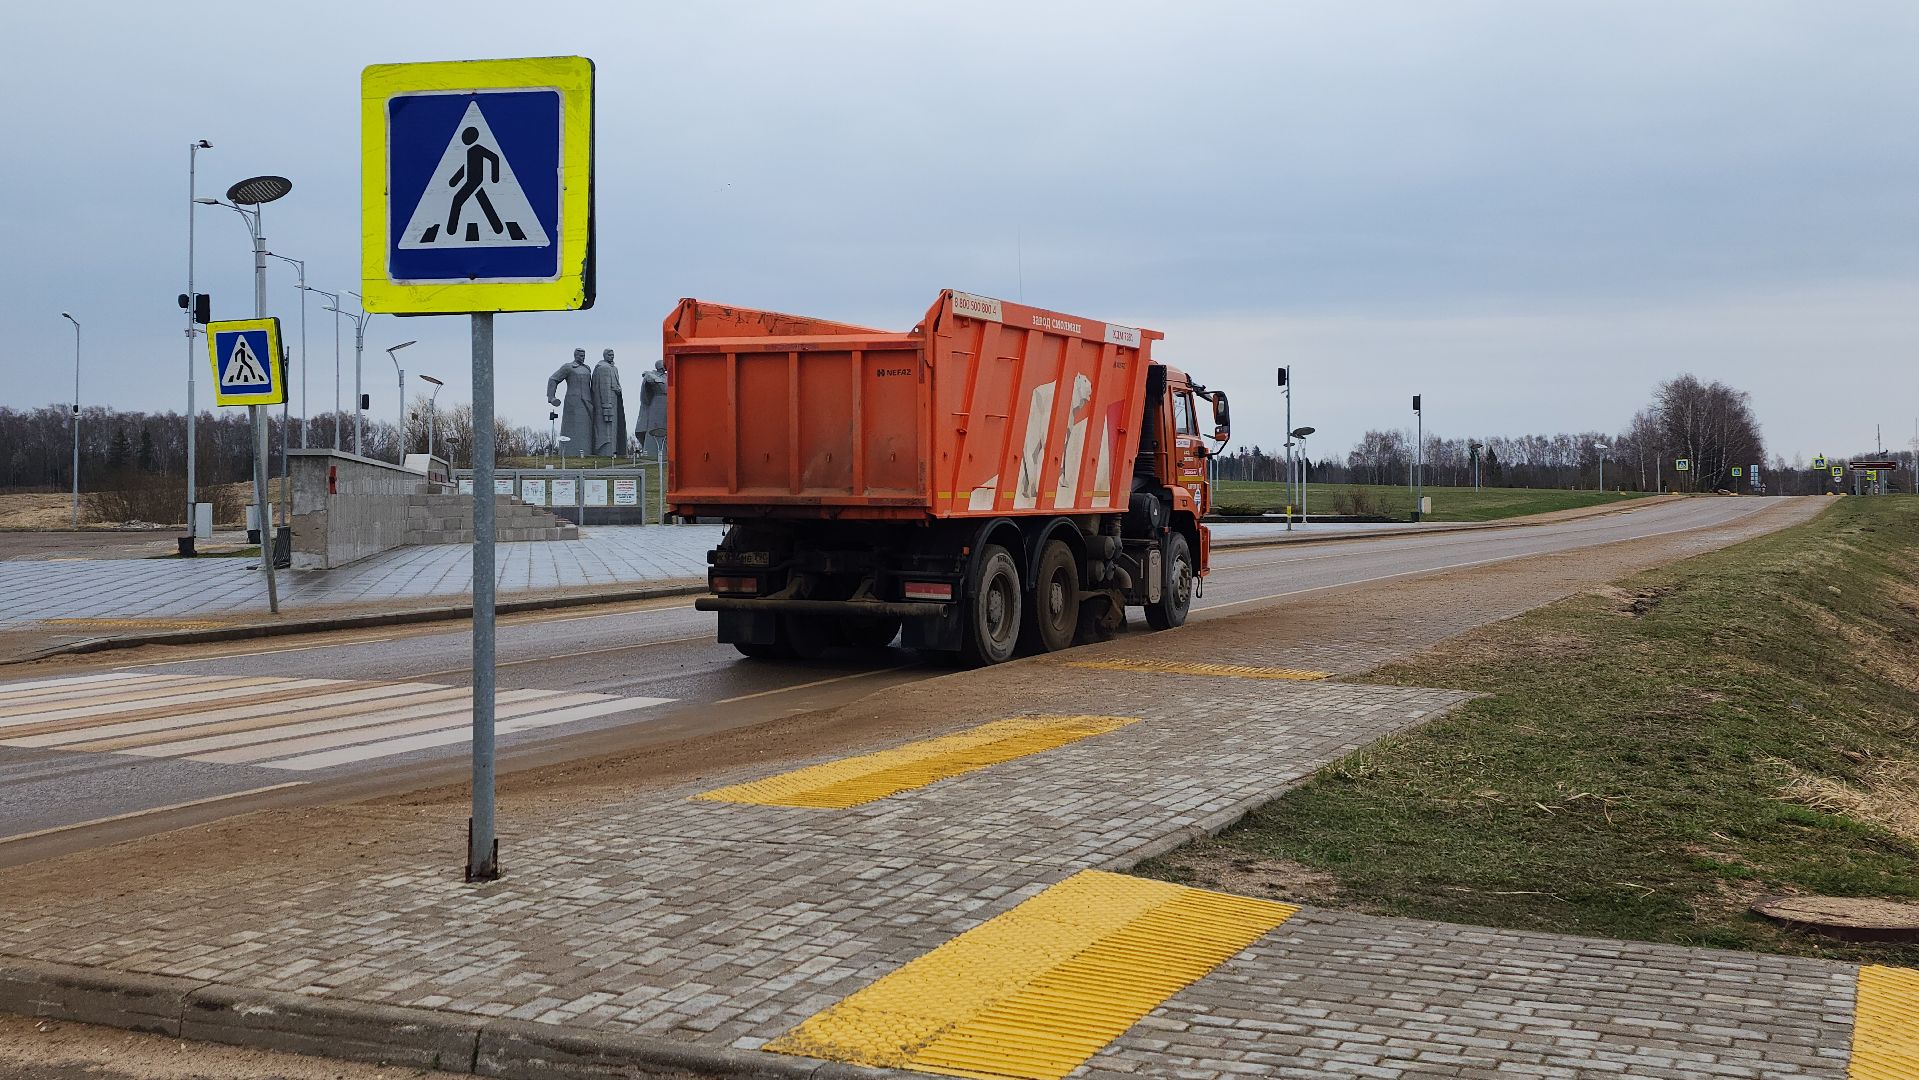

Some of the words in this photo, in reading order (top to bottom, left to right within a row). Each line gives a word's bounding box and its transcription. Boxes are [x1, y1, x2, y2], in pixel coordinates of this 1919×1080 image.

[954, 297, 958, 308] 8
[960, 298, 969, 310] 800
[971, 300, 980, 311] 500
[982, 303, 991, 314] 800
[1032, 315, 1050, 330] завод
